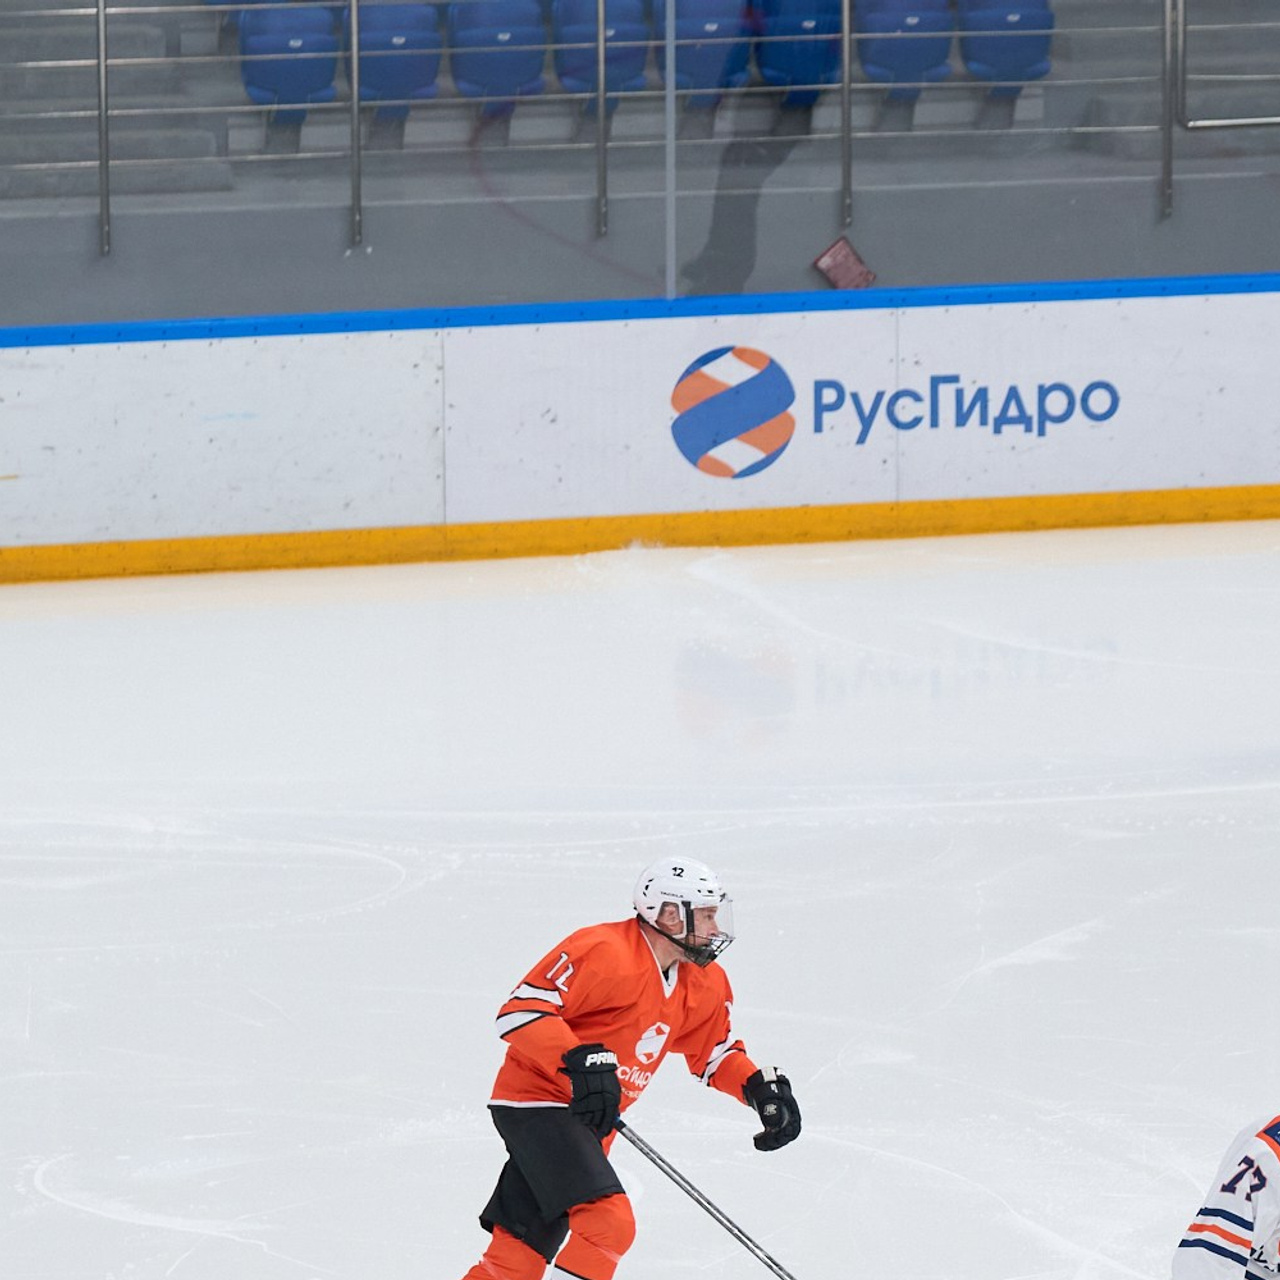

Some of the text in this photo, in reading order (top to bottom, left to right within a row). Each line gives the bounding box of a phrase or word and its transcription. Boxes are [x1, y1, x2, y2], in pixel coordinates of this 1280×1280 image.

[813, 374, 1120, 445] РусГидро
[671, 866, 685, 878] 12
[545, 952, 574, 992] 12
[1219, 1155, 1267, 1202] 77
